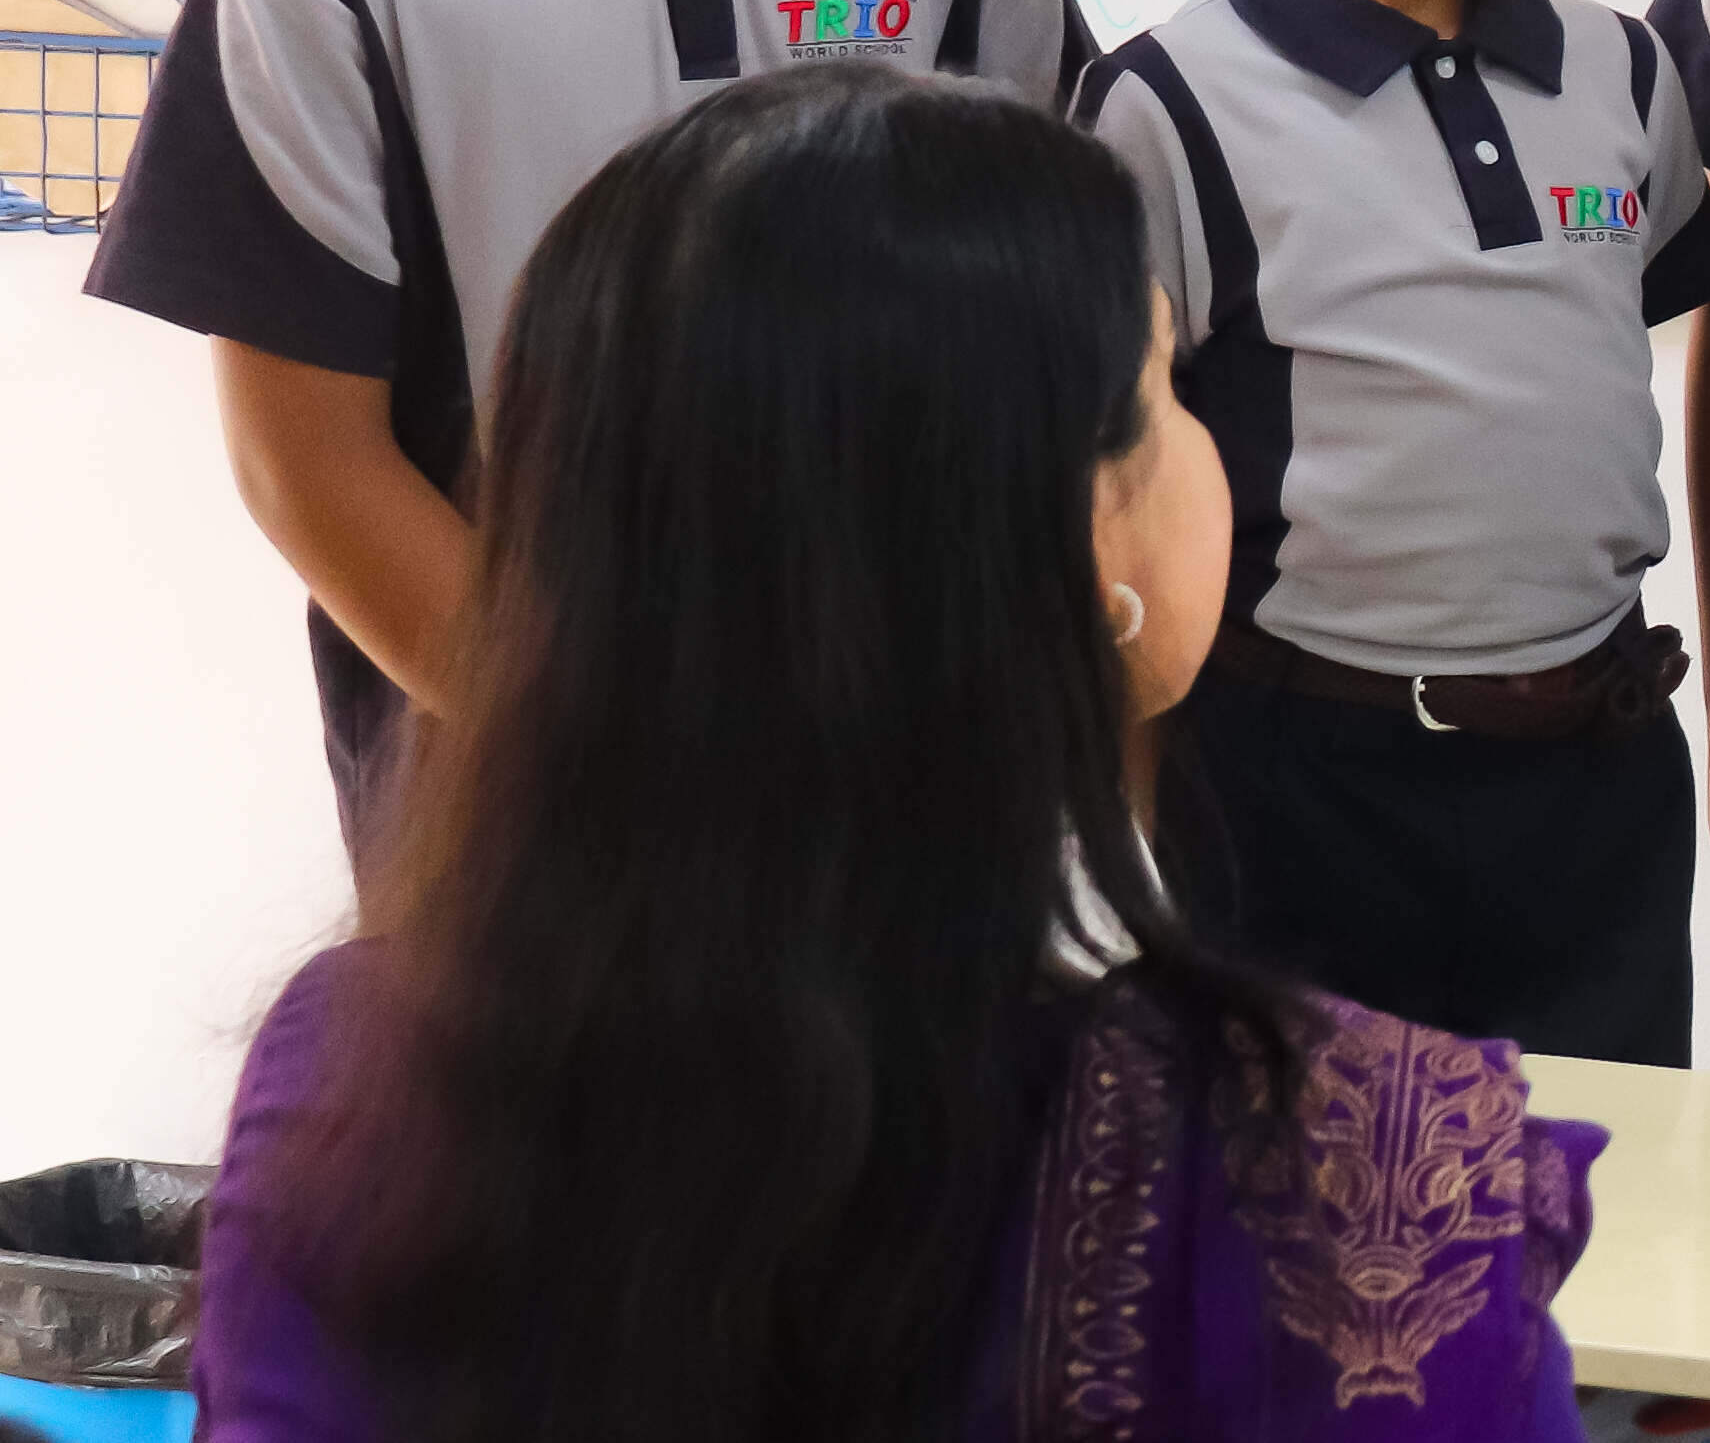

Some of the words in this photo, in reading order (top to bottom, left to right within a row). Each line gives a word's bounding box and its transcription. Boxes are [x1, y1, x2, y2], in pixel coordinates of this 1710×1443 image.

[789, 45, 848, 59] WORLD
[854, 42, 907, 55] SCHOOL
[1549, 185, 1639, 230] TRIO
